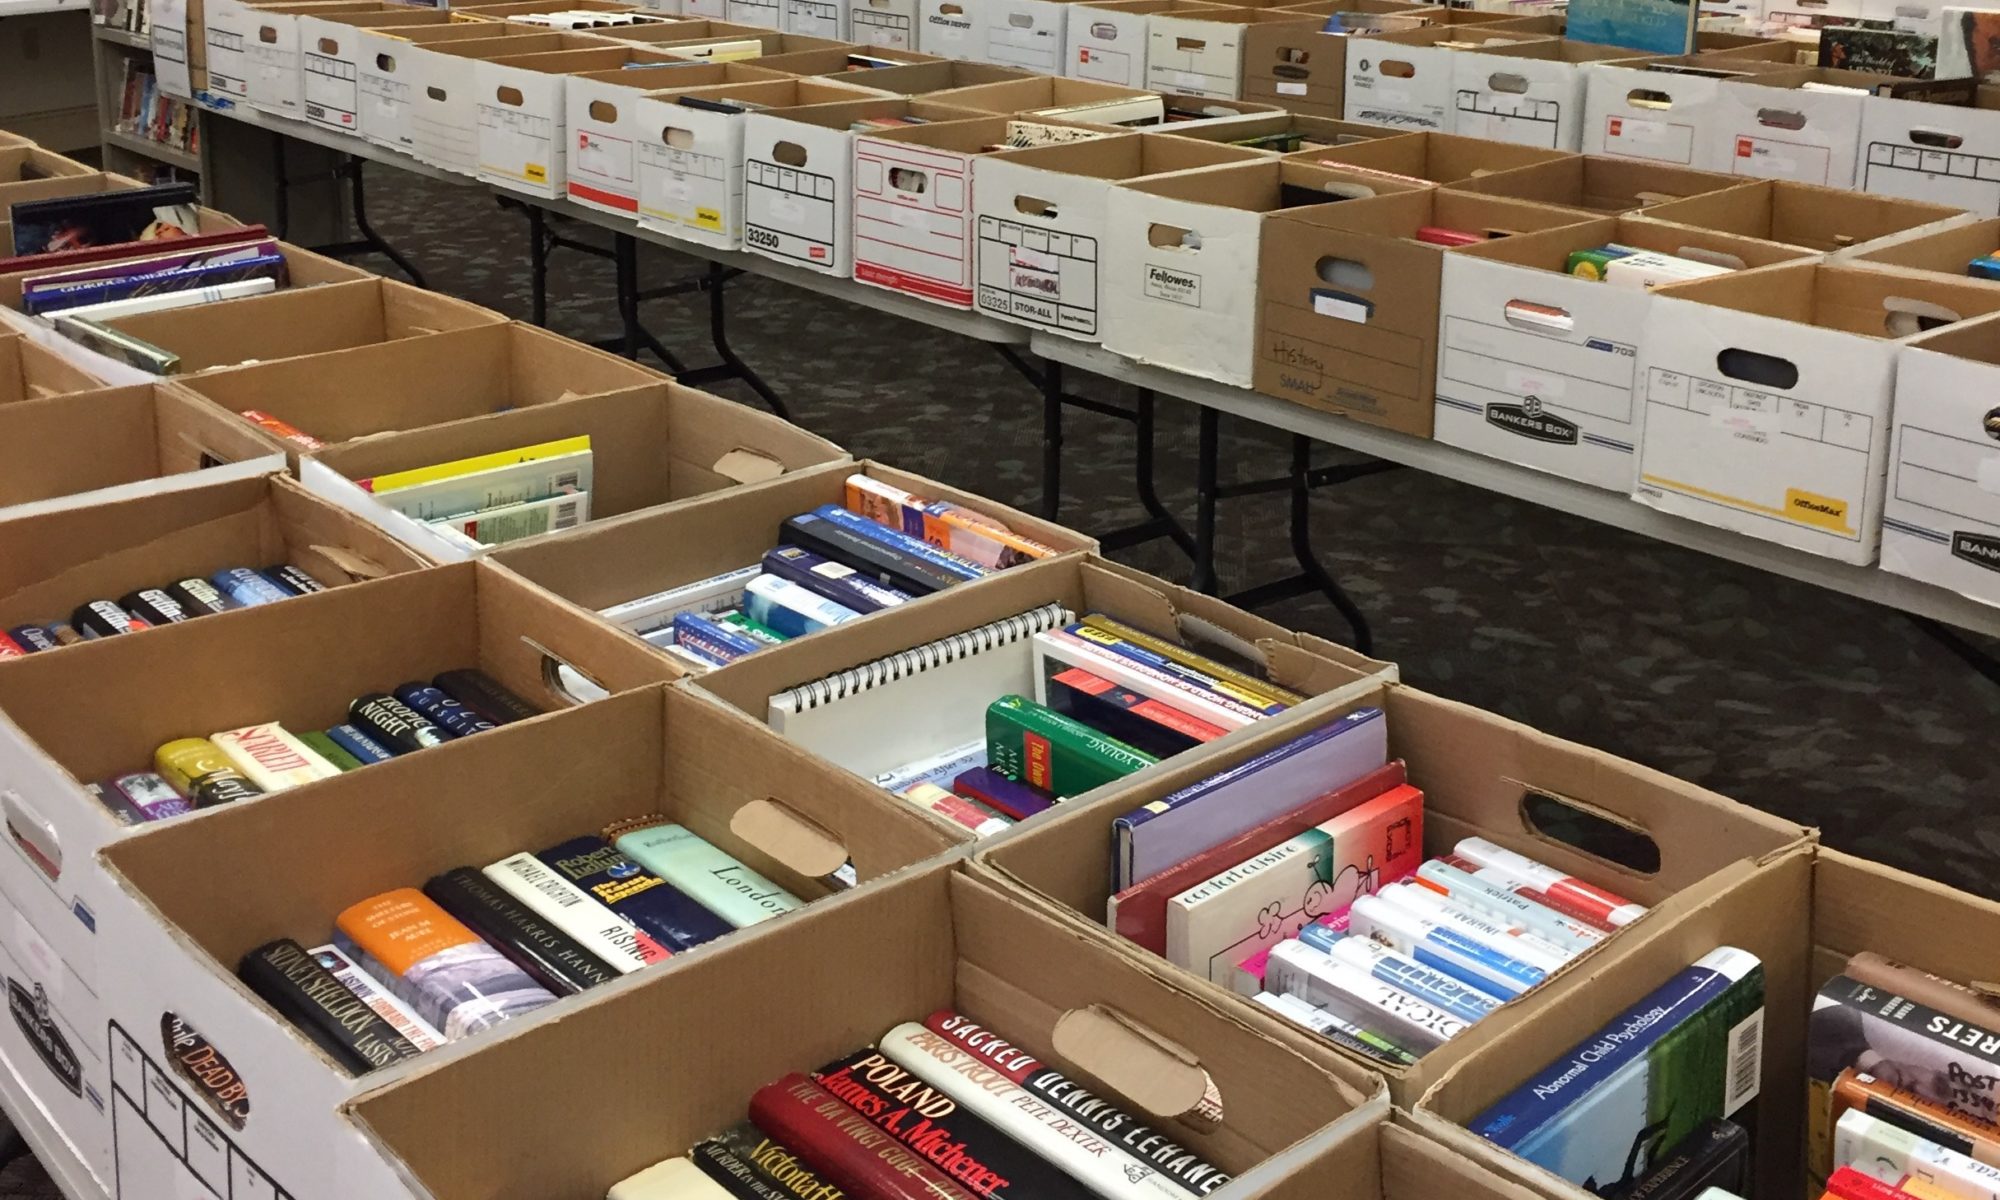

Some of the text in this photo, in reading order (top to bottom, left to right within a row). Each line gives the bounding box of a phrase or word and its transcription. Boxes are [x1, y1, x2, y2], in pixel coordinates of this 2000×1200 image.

[950, 20, 971, 29] DEPOT
[748, 228, 779, 249] 33250
[981, 293, 1008, 311] 03325
[1015, 301, 1052, 319] STOR-ALL
[1273, 340, 1325, 389] History
[1614, 346, 1635, 358] 703
[1491, 410, 1570, 438] BANKERS BOX
[1793, 498, 1843, 517] OfficeMax
[358, 701, 411, 737] NIGHT
[376, 695, 432, 730] TROPIC
[409, 690, 478, 737] PURSUIT
[932, 759, 958, 779] After
[1086, 735, 1134, 766] YOUNG
[505, 858, 584, 908] MICHAEL CRICHTON
[711, 864, 794, 917] London
[1484, 887, 1529, 911] Patrick
[452, 874, 506, 911] THOMAS
[506, 909, 560, 949] HARRIS
[600, 925, 657, 961] RISING
[262, 944, 381, 1036] SIDNEY SHELDON
[369, 997, 411, 1031] FORWARD
[401, 1023, 426, 1043] THE
[1926, 1015, 2000, 1055] RETS
[353, 1032, 396, 1067] LASTS
[1532, 1005, 1666, 1100] Abnormal Child Psychology
[181, 1046, 249, 1106] DEAD BY
[850, 1054, 956, 1118] POLAND
[905, 1031, 957, 1064] PARIS
[949, 1054, 1019, 1098] TROUT
[1011, 1094, 1051, 1122] PETE
[1048, 1117, 1112, 1159] DEXTER
[940, 1014, 1037, 1072] SACRED
[1032, 1071, 1126, 1133] DENNIS
[1121, 1126, 1231, 1195] LEHANE
[787, 1081, 826, 1106] THE
[815, 1101, 847, 1121] DA
[837, 1115, 887, 1149] VINCI
[878, 1147, 928, 1179] CODE
[816, 1066, 1009, 1197] James A. Michener
[705, 1144, 751, 1178] MURDER
[749, 1137, 820, 1200] Victoria
[1642, 1155, 1690, 1194] EXPERIENCE
